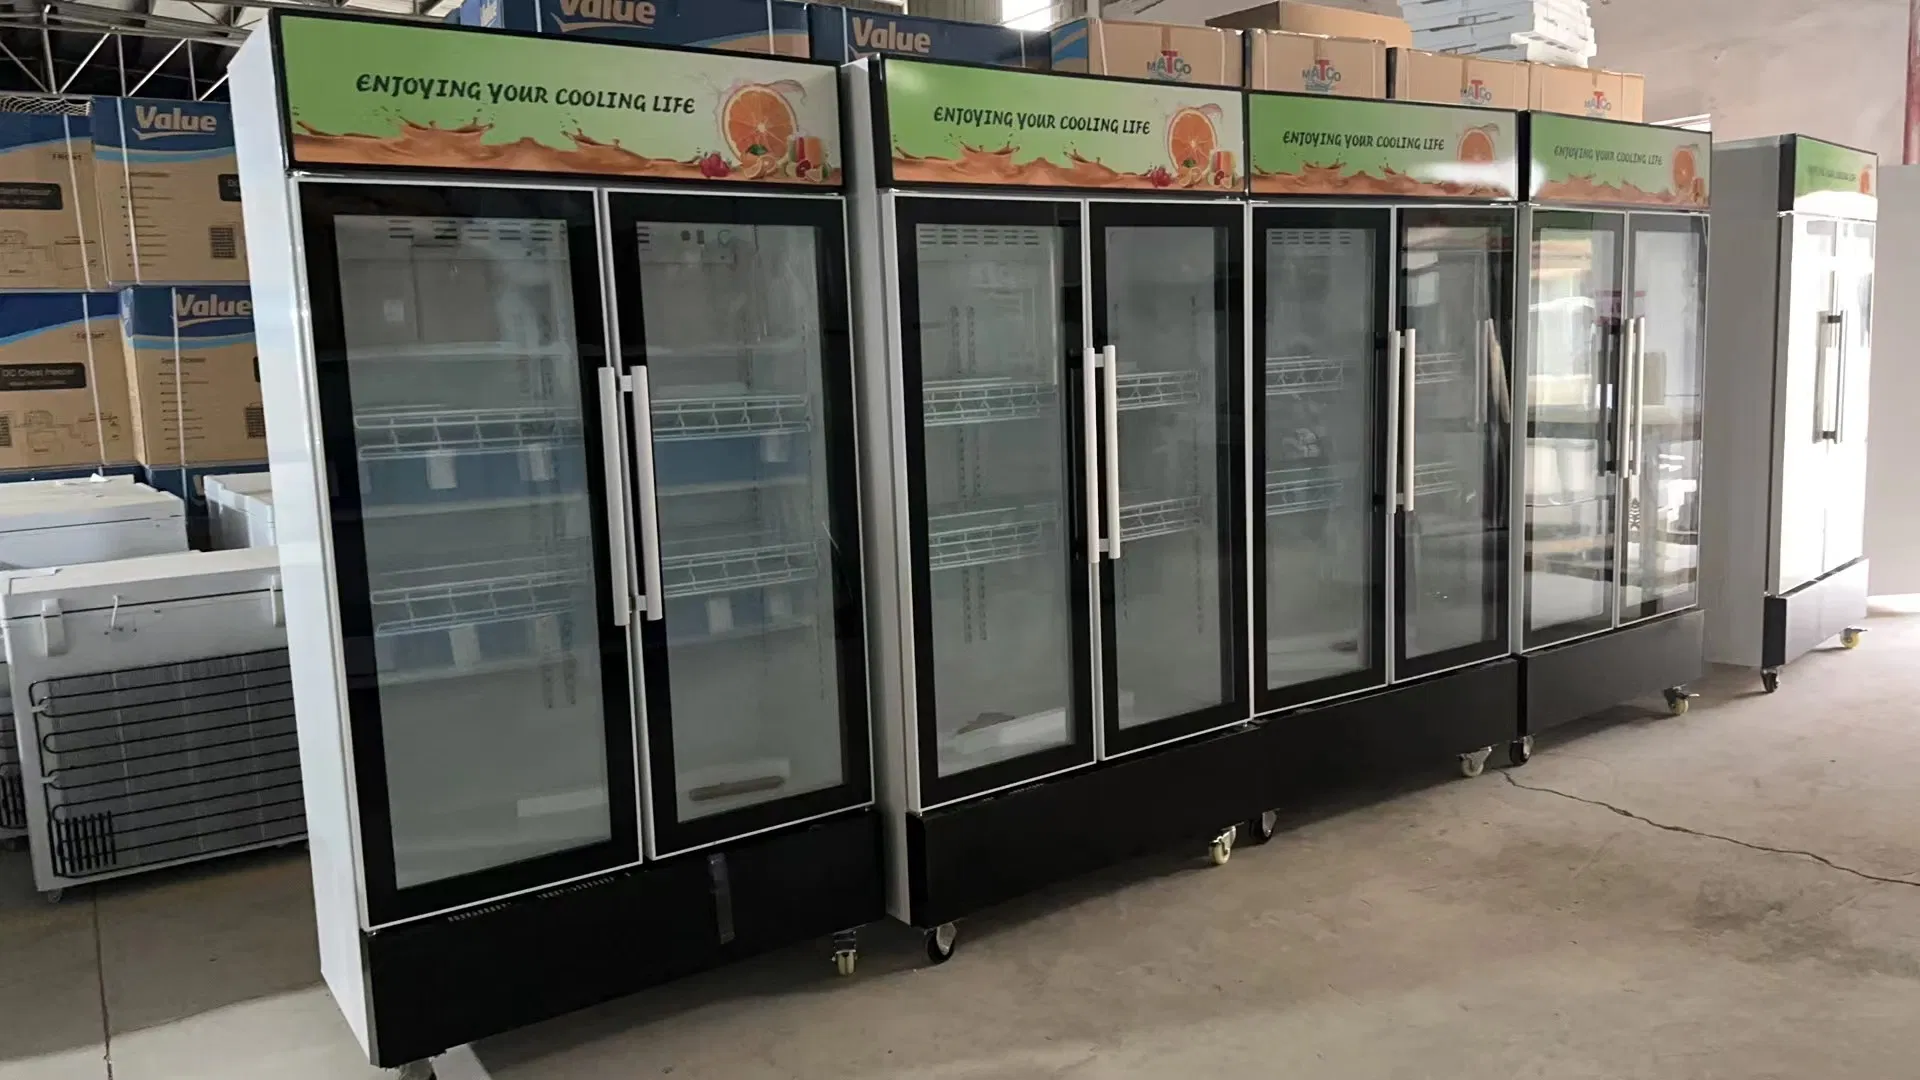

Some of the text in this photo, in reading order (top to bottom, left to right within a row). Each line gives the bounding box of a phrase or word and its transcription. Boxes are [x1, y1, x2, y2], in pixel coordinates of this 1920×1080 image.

[559, 0, 657, 25] Value
[852, 16, 931, 54] Value
[356, 74, 695, 114] ENJOYING YOUR COOLING LIFE
[135, 105, 217, 131] Value
[934, 106, 1150, 135] ENJOYING YOUR COOLING LIFE
[1282, 130, 1444, 150] ENJOYING YOUR COOLING LIFE
[175, 293, 253, 316] Value
